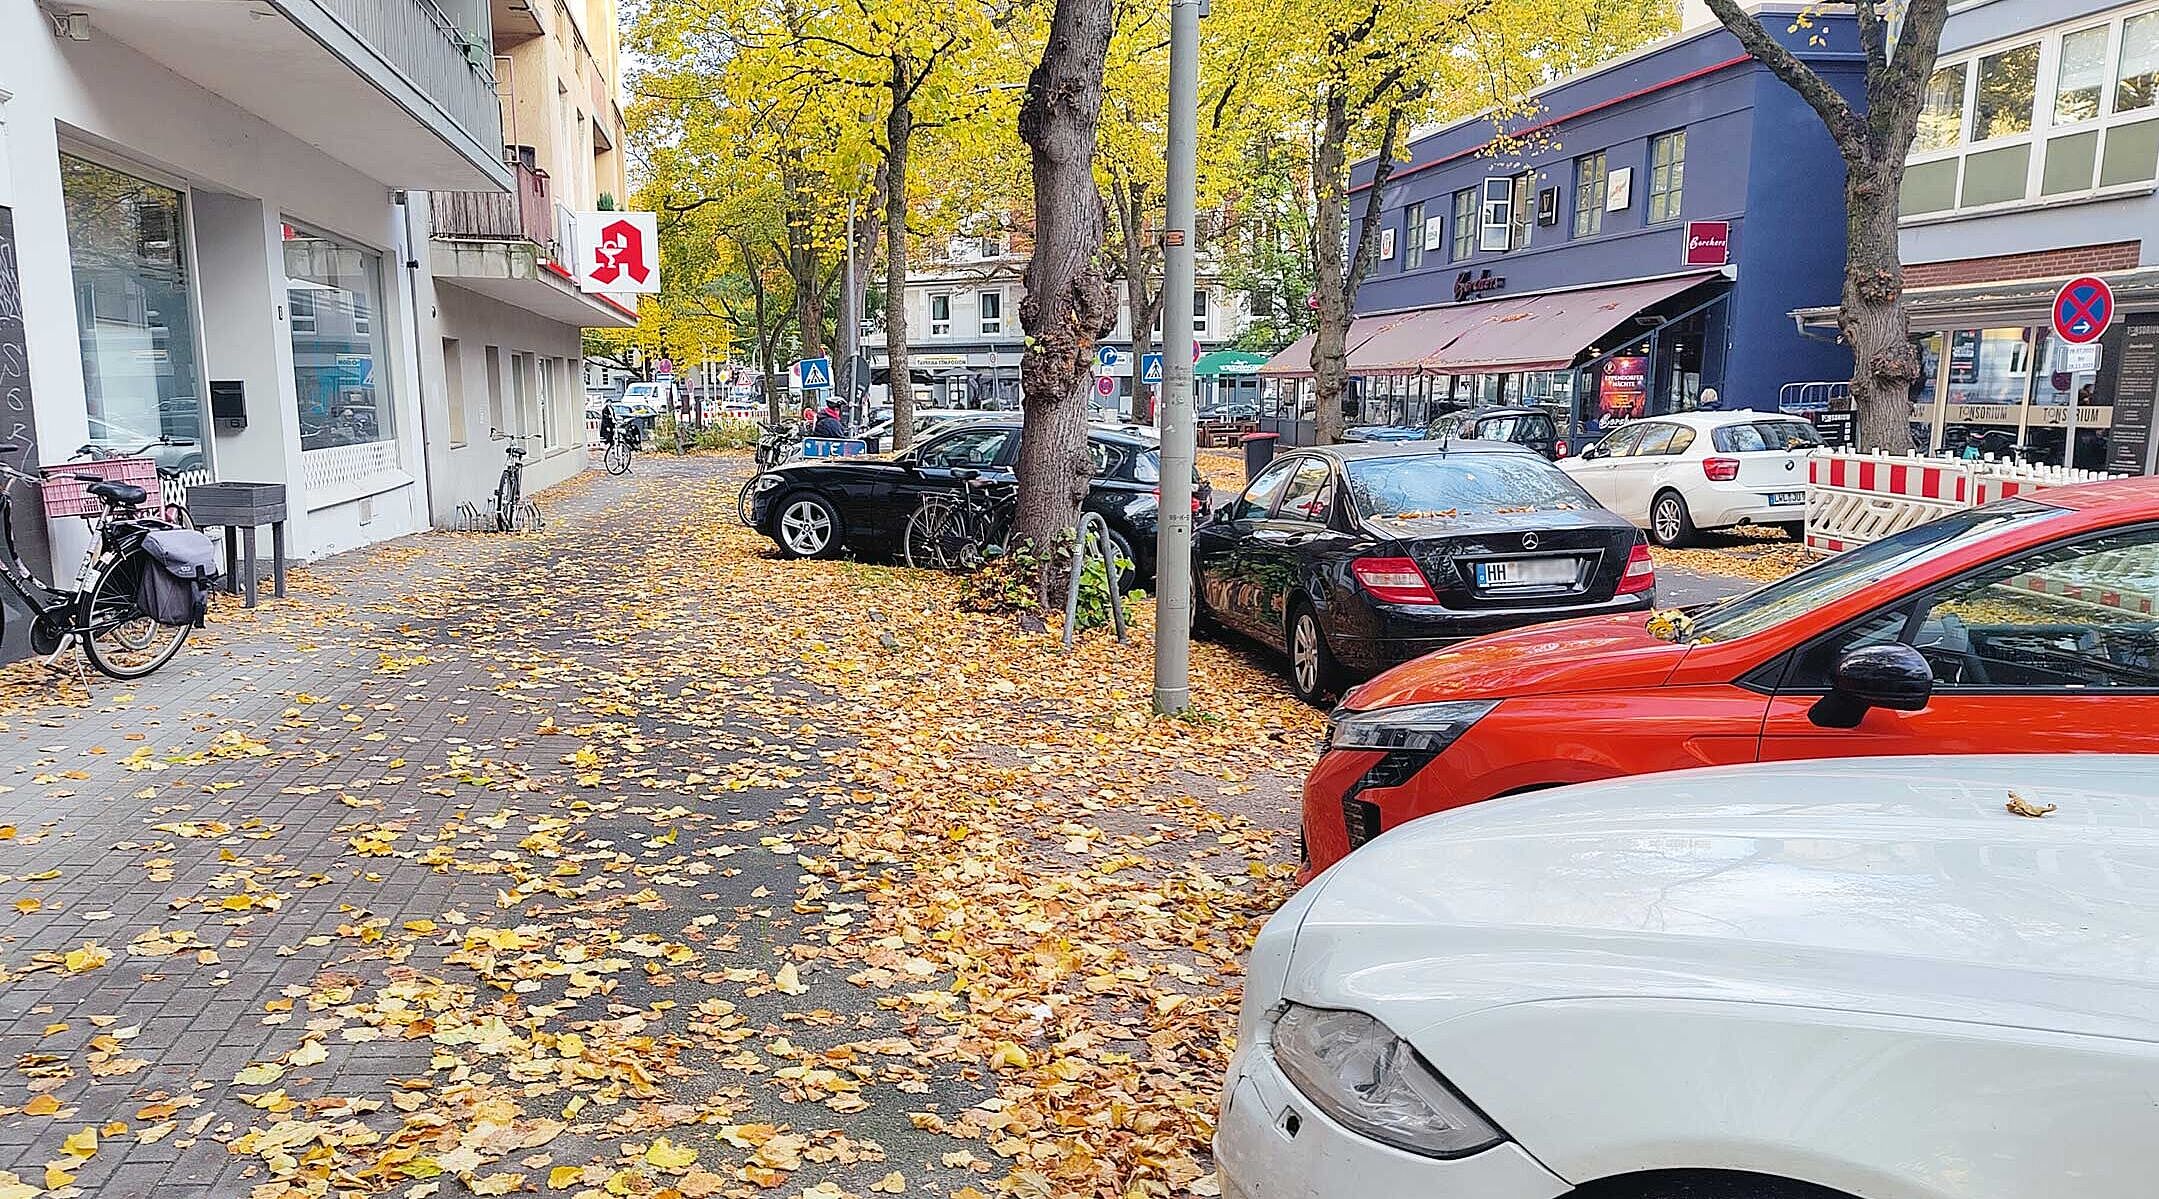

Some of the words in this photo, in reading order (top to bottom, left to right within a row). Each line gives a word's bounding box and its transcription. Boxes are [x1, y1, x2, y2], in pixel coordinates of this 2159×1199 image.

[1690, 236, 1726, 249] Borchers
[2043, 408, 2099, 424] TONSRIUM
[1487, 564, 1507, 581] HH
